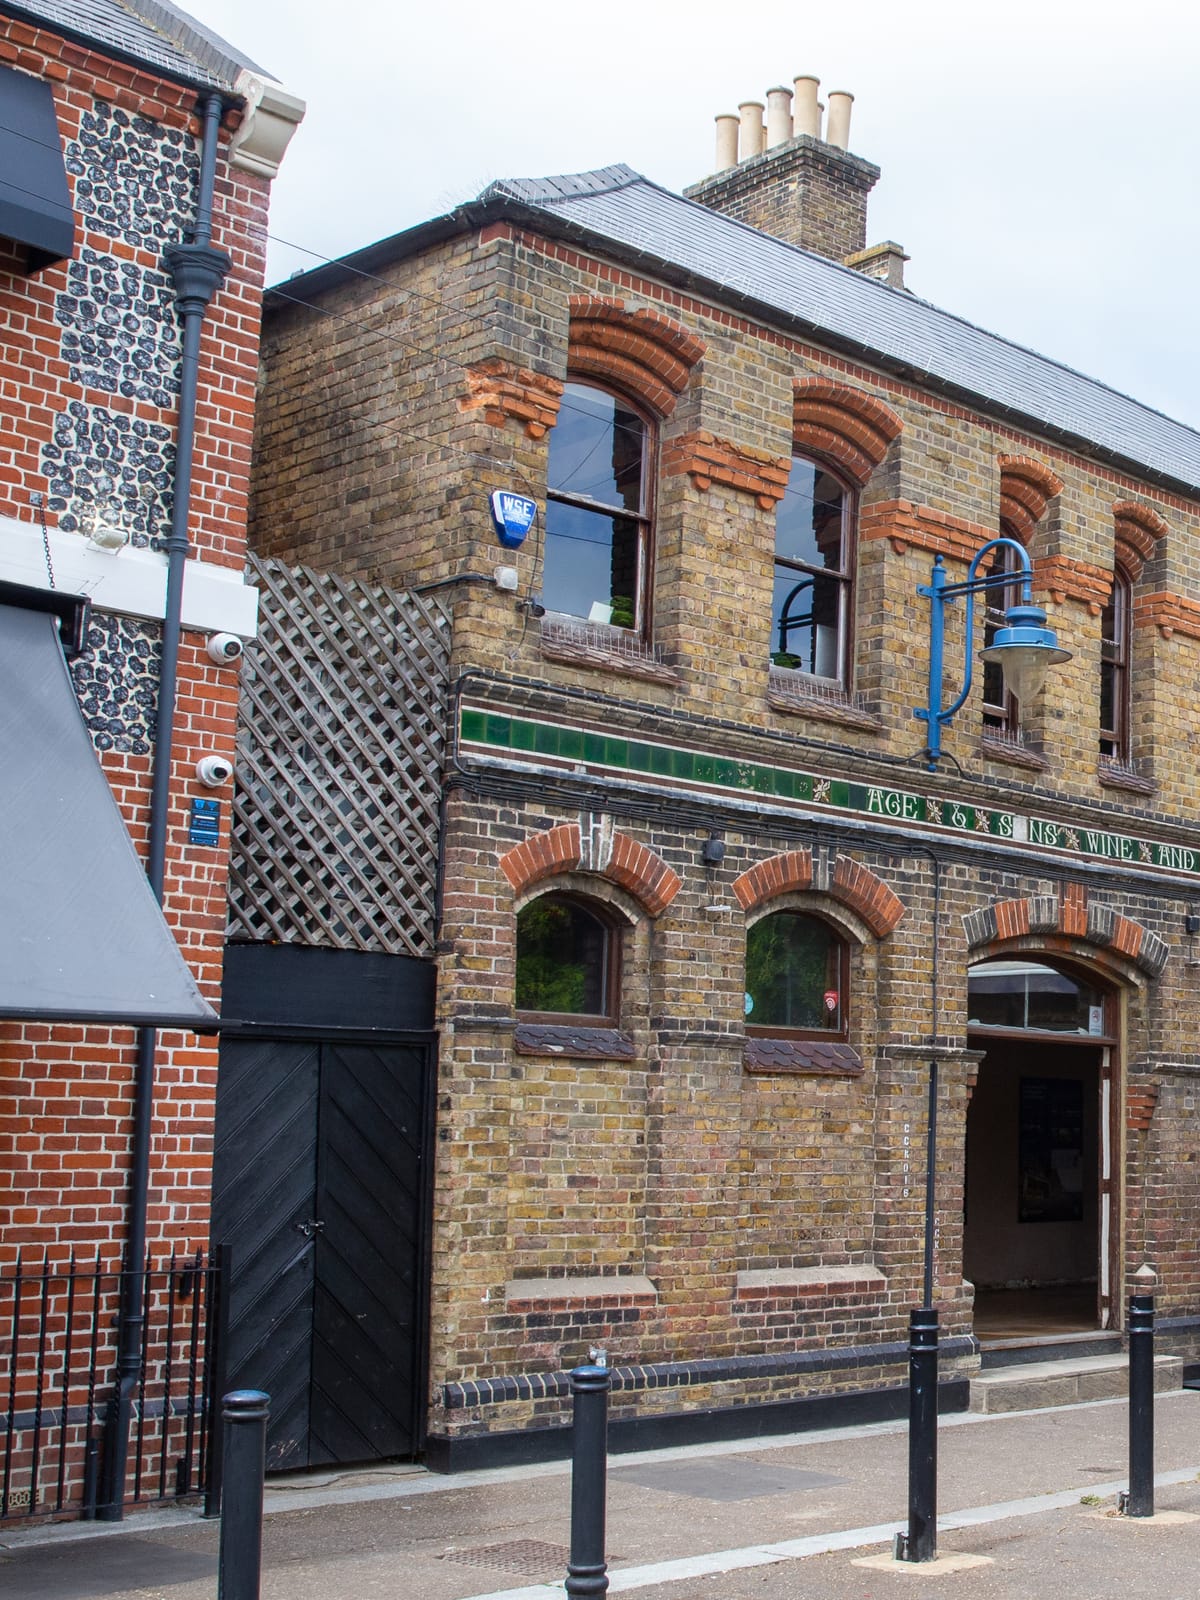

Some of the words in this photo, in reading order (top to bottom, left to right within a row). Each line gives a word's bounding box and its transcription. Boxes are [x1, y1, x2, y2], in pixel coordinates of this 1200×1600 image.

[503, 495, 532, 517] WSE
[866, 788, 918, 819] AGE
[951, 803, 966, 829] &
[1086, 831, 1134, 860] WINE
[1158, 845, 1195, 871] AND
